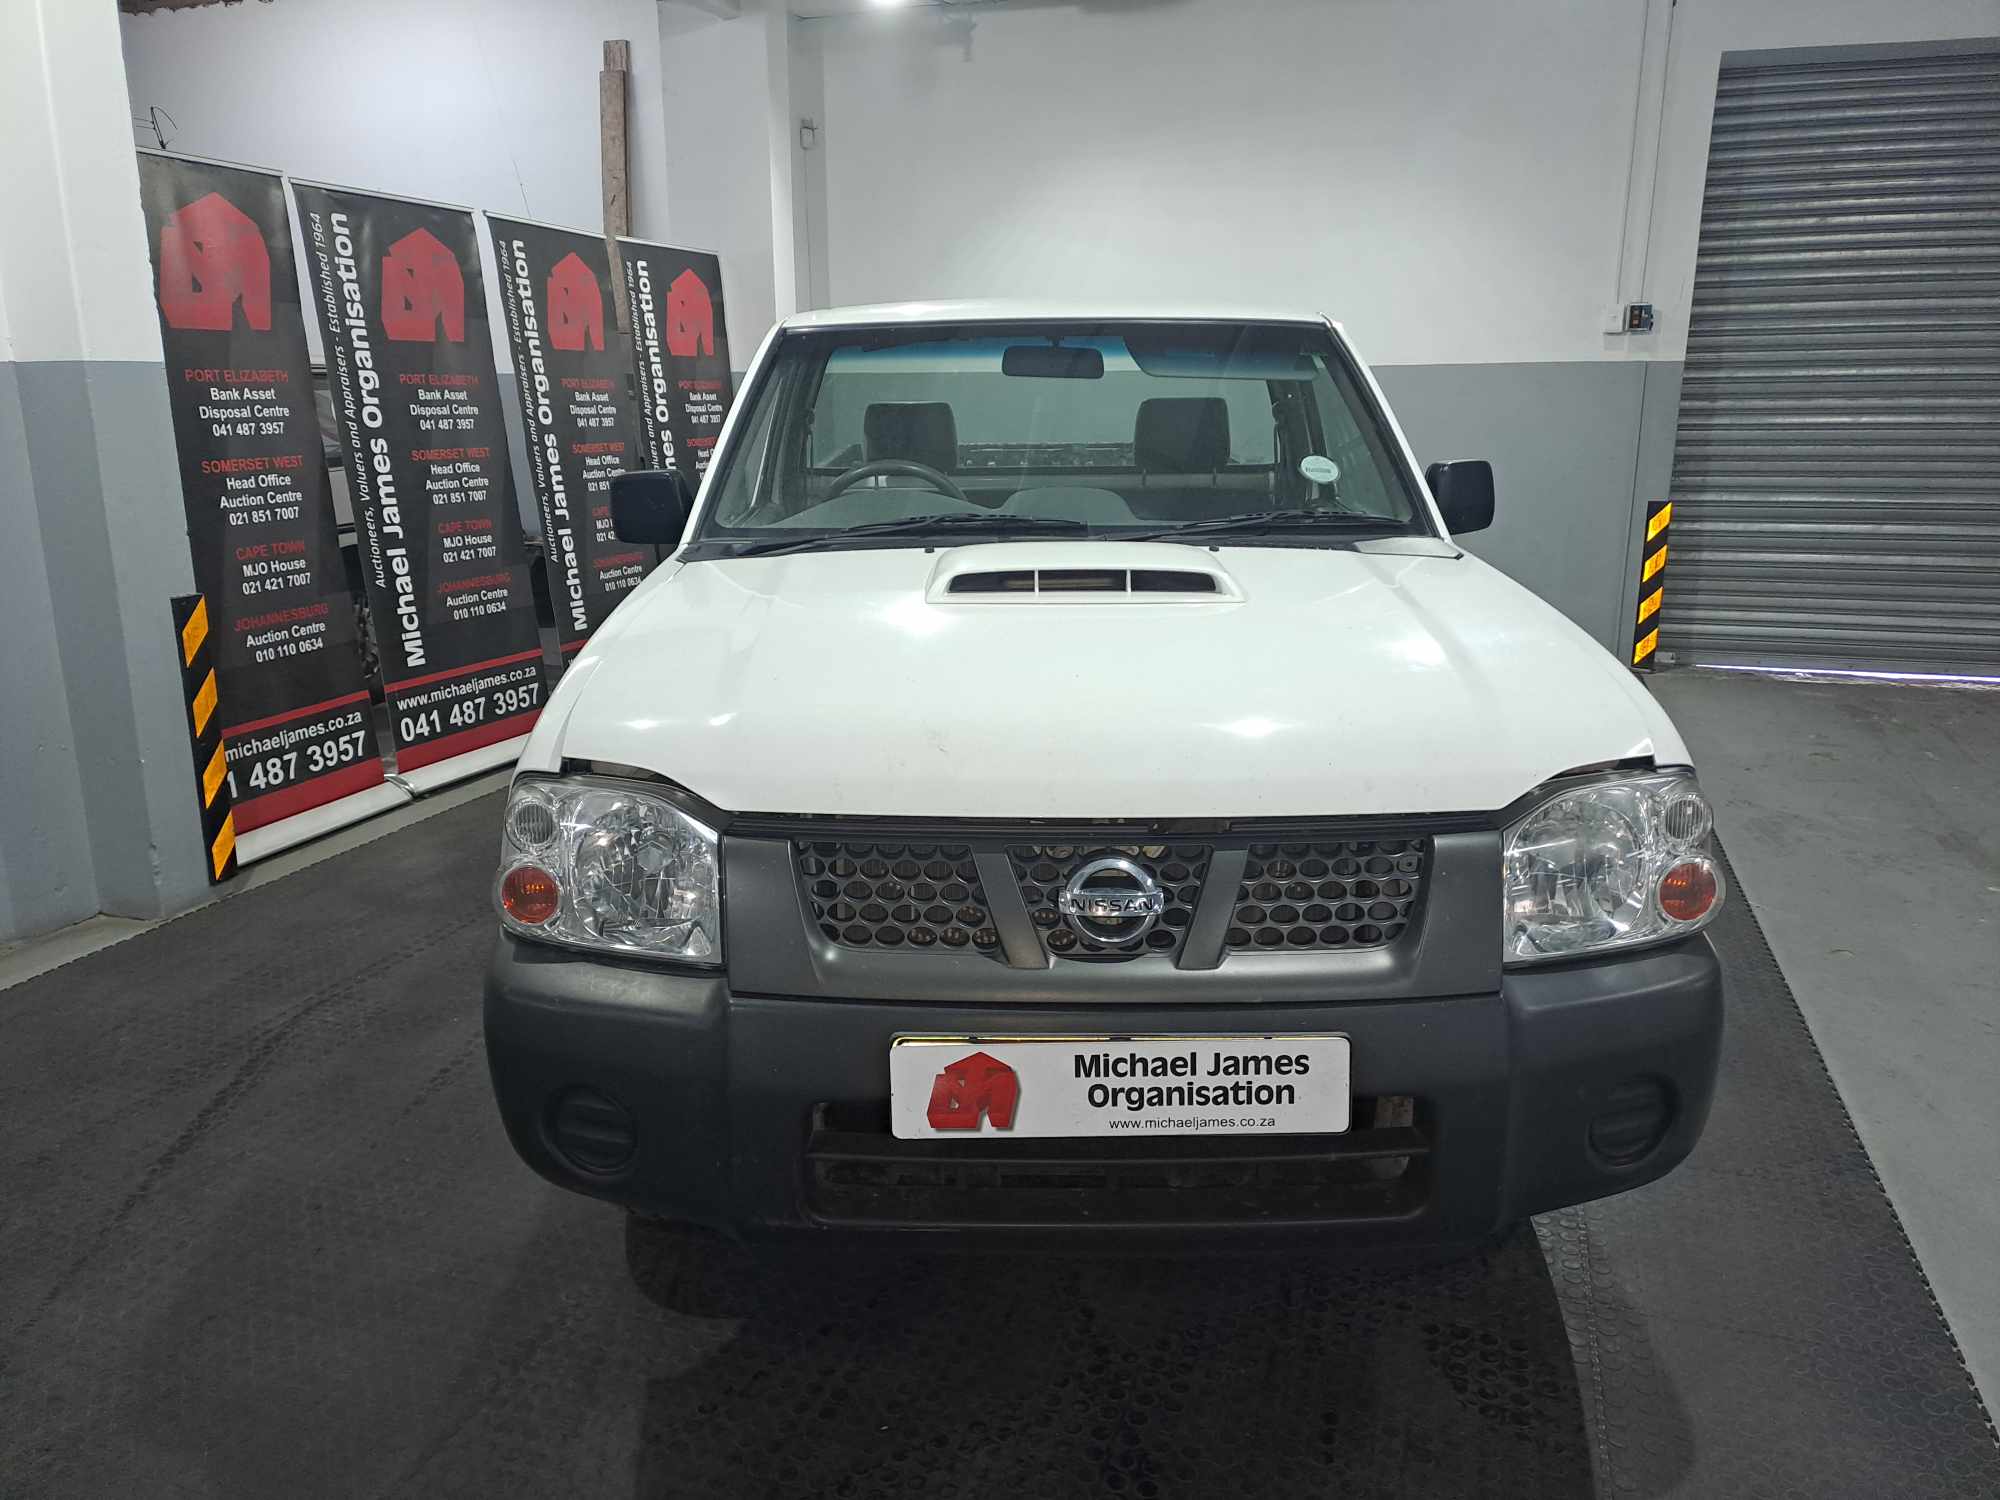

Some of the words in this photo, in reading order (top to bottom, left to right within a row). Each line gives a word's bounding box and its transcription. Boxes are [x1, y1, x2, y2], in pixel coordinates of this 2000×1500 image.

[310, 212, 326, 248] 1964
[316, 251, 341, 334] Established
[184, 369, 220, 382] PORT
[335, 345, 357, 420] Appraisers
[210, 388, 240, 400] Bank
[244, 388, 276, 400] Asset
[418, 389, 442, 400] Bank
[444, 390, 468, 400] Asset
[199, 405, 251, 421] Disposal
[254, 405, 290, 418] Centre
[410, 404, 450, 418] Disposal
[452, 404, 479, 415] Centre
[212, 423, 232, 436] 041
[236, 422, 255, 436] 487
[260, 422, 284, 434] 3957
[344, 420, 361, 448] and
[420, 419, 436, 431] 041
[438, 419, 454, 430] 487
[527, 418, 538, 442] and
[201, 457, 270, 474] SOMERSET
[272, 455, 303, 468] WEST
[430, 464, 454, 475] Head
[455, 462, 480, 474] Office
[532, 445, 546, 488] Valuers
[226, 476, 256, 490] Head
[258, 474, 292, 487] Office
[354, 450, 370, 502] Valuers
[426, 478, 460, 490] Auction
[462, 477, 489, 488] Centre
[544, 433, 570, 521] James
[370, 438, 404, 540] James
[432, 494, 448, 505] 021
[450, 492, 466, 504] 851
[468, 490, 487, 502] 7007
[220, 494, 264, 508] Auction
[267, 491, 302, 504] Centre
[229, 512, 249, 526] 021
[252, 510, 272, 522] 851
[274, 506, 300, 520] 7007
[362, 506, 387, 588] Auctioneers,
[443, 536, 463, 548] MJO
[464, 534, 492, 546] House
[236, 545, 269, 560] CAPE
[443, 552, 458, 564] 021
[460, 549, 475, 560] 421
[477, 546, 496, 558] 7007
[242, 562, 268, 578] MJO
[270, 560, 306, 573] House
[242, 581, 262, 595] 021
[264, 577, 284, 591] 421
[287, 572, 311, 588] 7007
[557, 528, 588, 632] Michael
[386, 548, 426, 668] Michael
[446, 594, 479, 608] Auction
[481, 588, 508, 600] Centre
[453, 608, 469, 620] 010
[470, 605, 485, 617] 110
[246, 630, 290, 648] Auction
[292, 622, 326, 638] Centre
[255, 648, 275, 663] 010
[277, 644, 296, 658] 110
[299, 637, 324, 652] 0634
[396, 666, 536, 711] www.michaeljames.co.za
[400, 709, 442, 742] 041
[450, 697, 486, 726] 487
[493, 682, 540, 715] 3957
[224, 712, 362, 762] michaeljames.co.za
[249, 752, 298, 790] 487
[306, 730, 366, 772] 3957
[1071, 898, 1153, 912] NISSAN
[1074, 1052, 1197, 1078] Michael
[1206, 1051, 1310, 1077] James
[1087, 1081, 1296, 1112] Organisation
[1108, 1116, 1276, 1131] www.michaeljames.co.za
